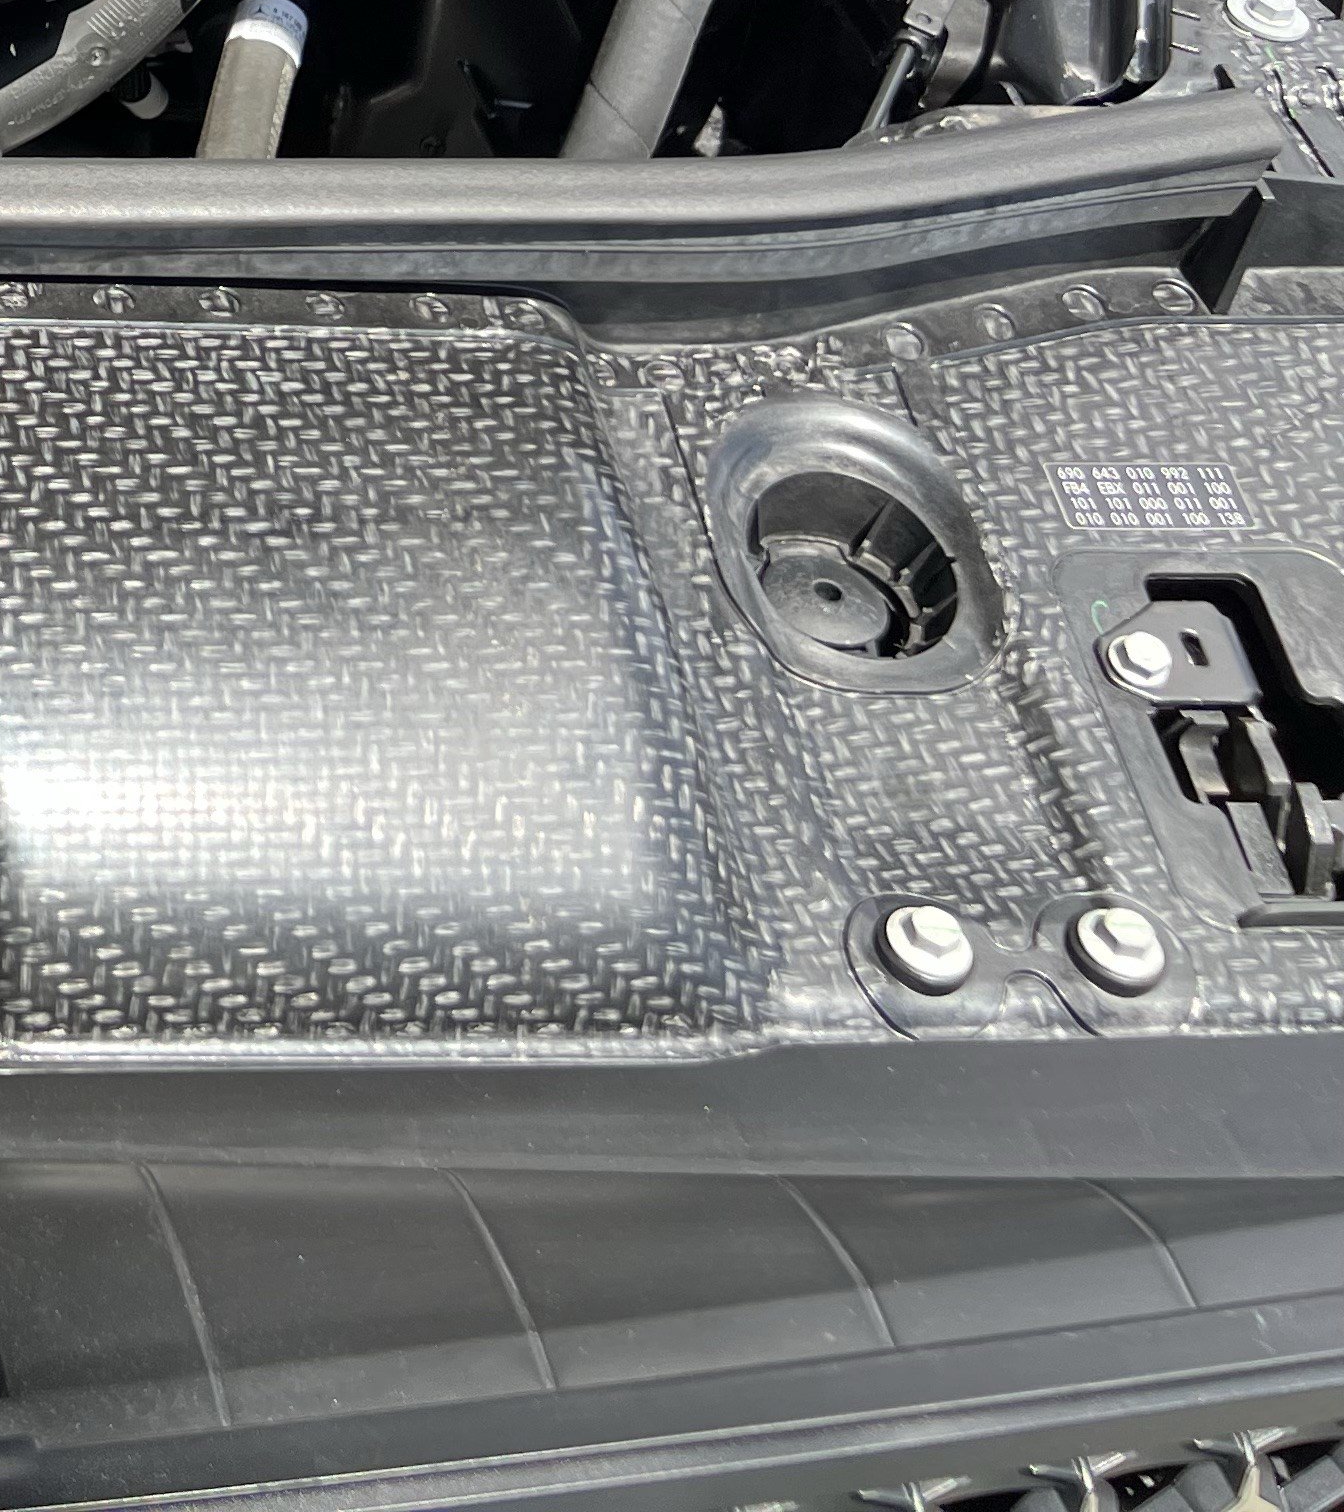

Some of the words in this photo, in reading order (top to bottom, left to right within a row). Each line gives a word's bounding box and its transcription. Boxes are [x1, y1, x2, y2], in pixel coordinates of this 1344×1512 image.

[1057, 467, 1086, 480] 690
[1092, 467, 1121, 480] 643
[1126, 467, 1156, 480] 010
[1160, 467, 1190, 480] 992
[1197, 467, 1225, 481] 111
[1097, 481, 1127, 495] EBX
[1132, 482, 1162, 496] 011
[1167, 482, 1196, 496] 001
[1204, 482, 1233, 495] 100
[1070, 497, 1098, 511] 101
[1105, 497, 1133, 511] 101
[1139, 497, 1169, 510] 000
[1174, 497, 1203, 511] 011
[1209, 497, 1238, 511] 001
[1075, 512, 1105, 526] 010
[1110, 512, 1140, 526] 010
[1145, 512, 1175, 527] 001
[1182, 512, 1212, 526] 100
[1217, 512, 1247, 526] 138
